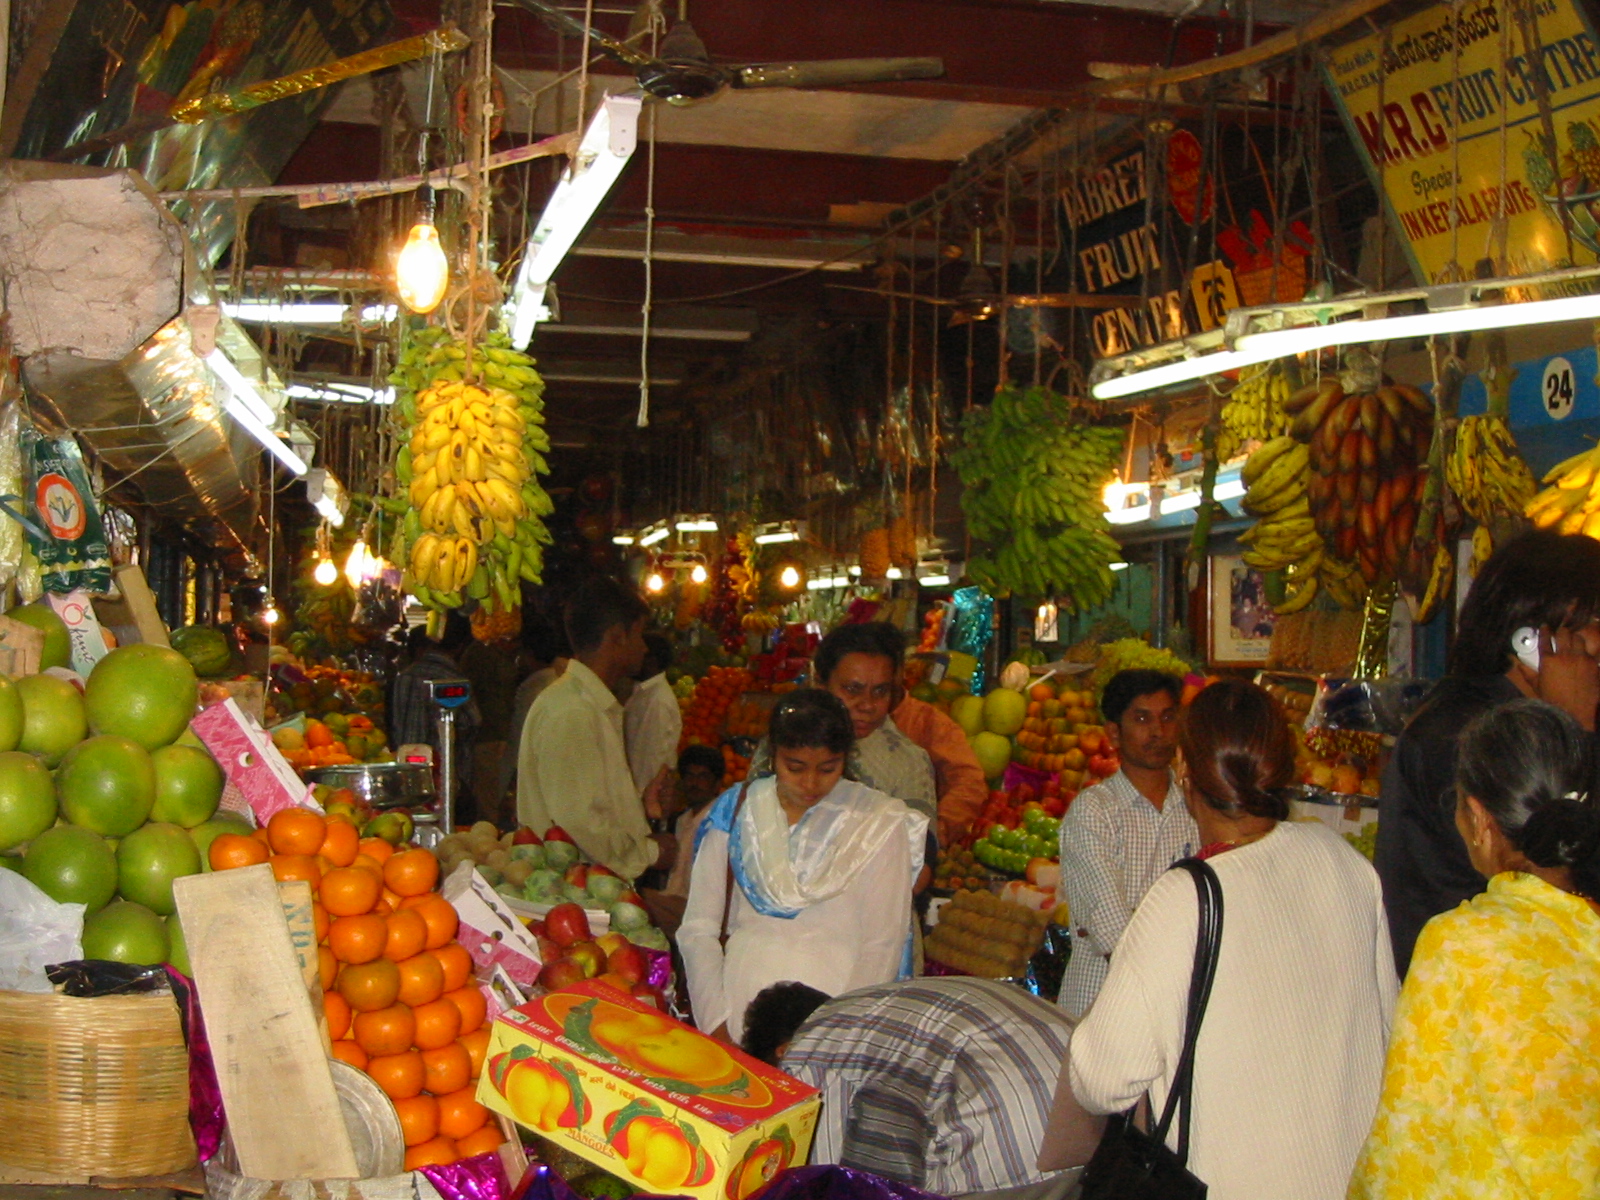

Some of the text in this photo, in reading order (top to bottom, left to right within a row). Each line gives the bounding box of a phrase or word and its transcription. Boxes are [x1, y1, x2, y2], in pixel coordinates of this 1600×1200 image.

[1430, 67, 1502, 128] FRUIT
[1411, 163, 1463, 200] Special
[1400, 207, 1424, 242] IN
[1417, 192, 1490, 237] KERALA
[1079, 221, 1162, 293] FRUIT
[1546, 368, 1573, 410] 24
[566, 1128, 616, 1159] MANGOES
